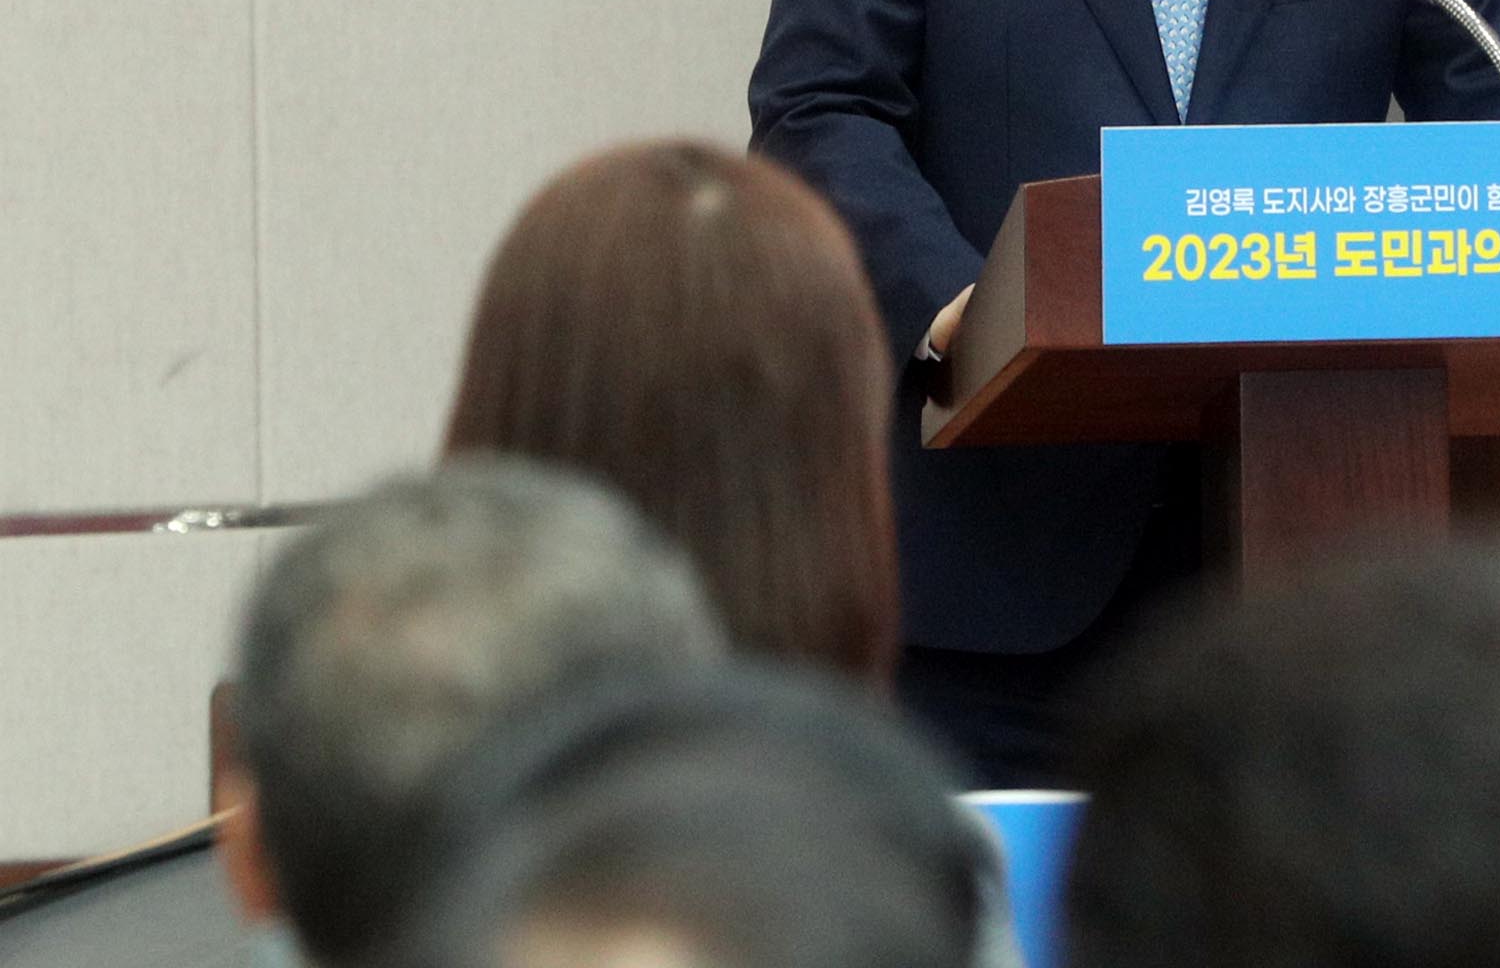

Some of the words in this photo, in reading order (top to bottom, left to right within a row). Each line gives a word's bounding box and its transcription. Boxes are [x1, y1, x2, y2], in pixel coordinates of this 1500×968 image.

[1186, 187, 1255, 216] 김영록
[1262, 186, 1357, 214] 도지사와
[1363, 184, 1479, 213] 장흥군민이
[1141, 231, 1318, 281] 2023년
